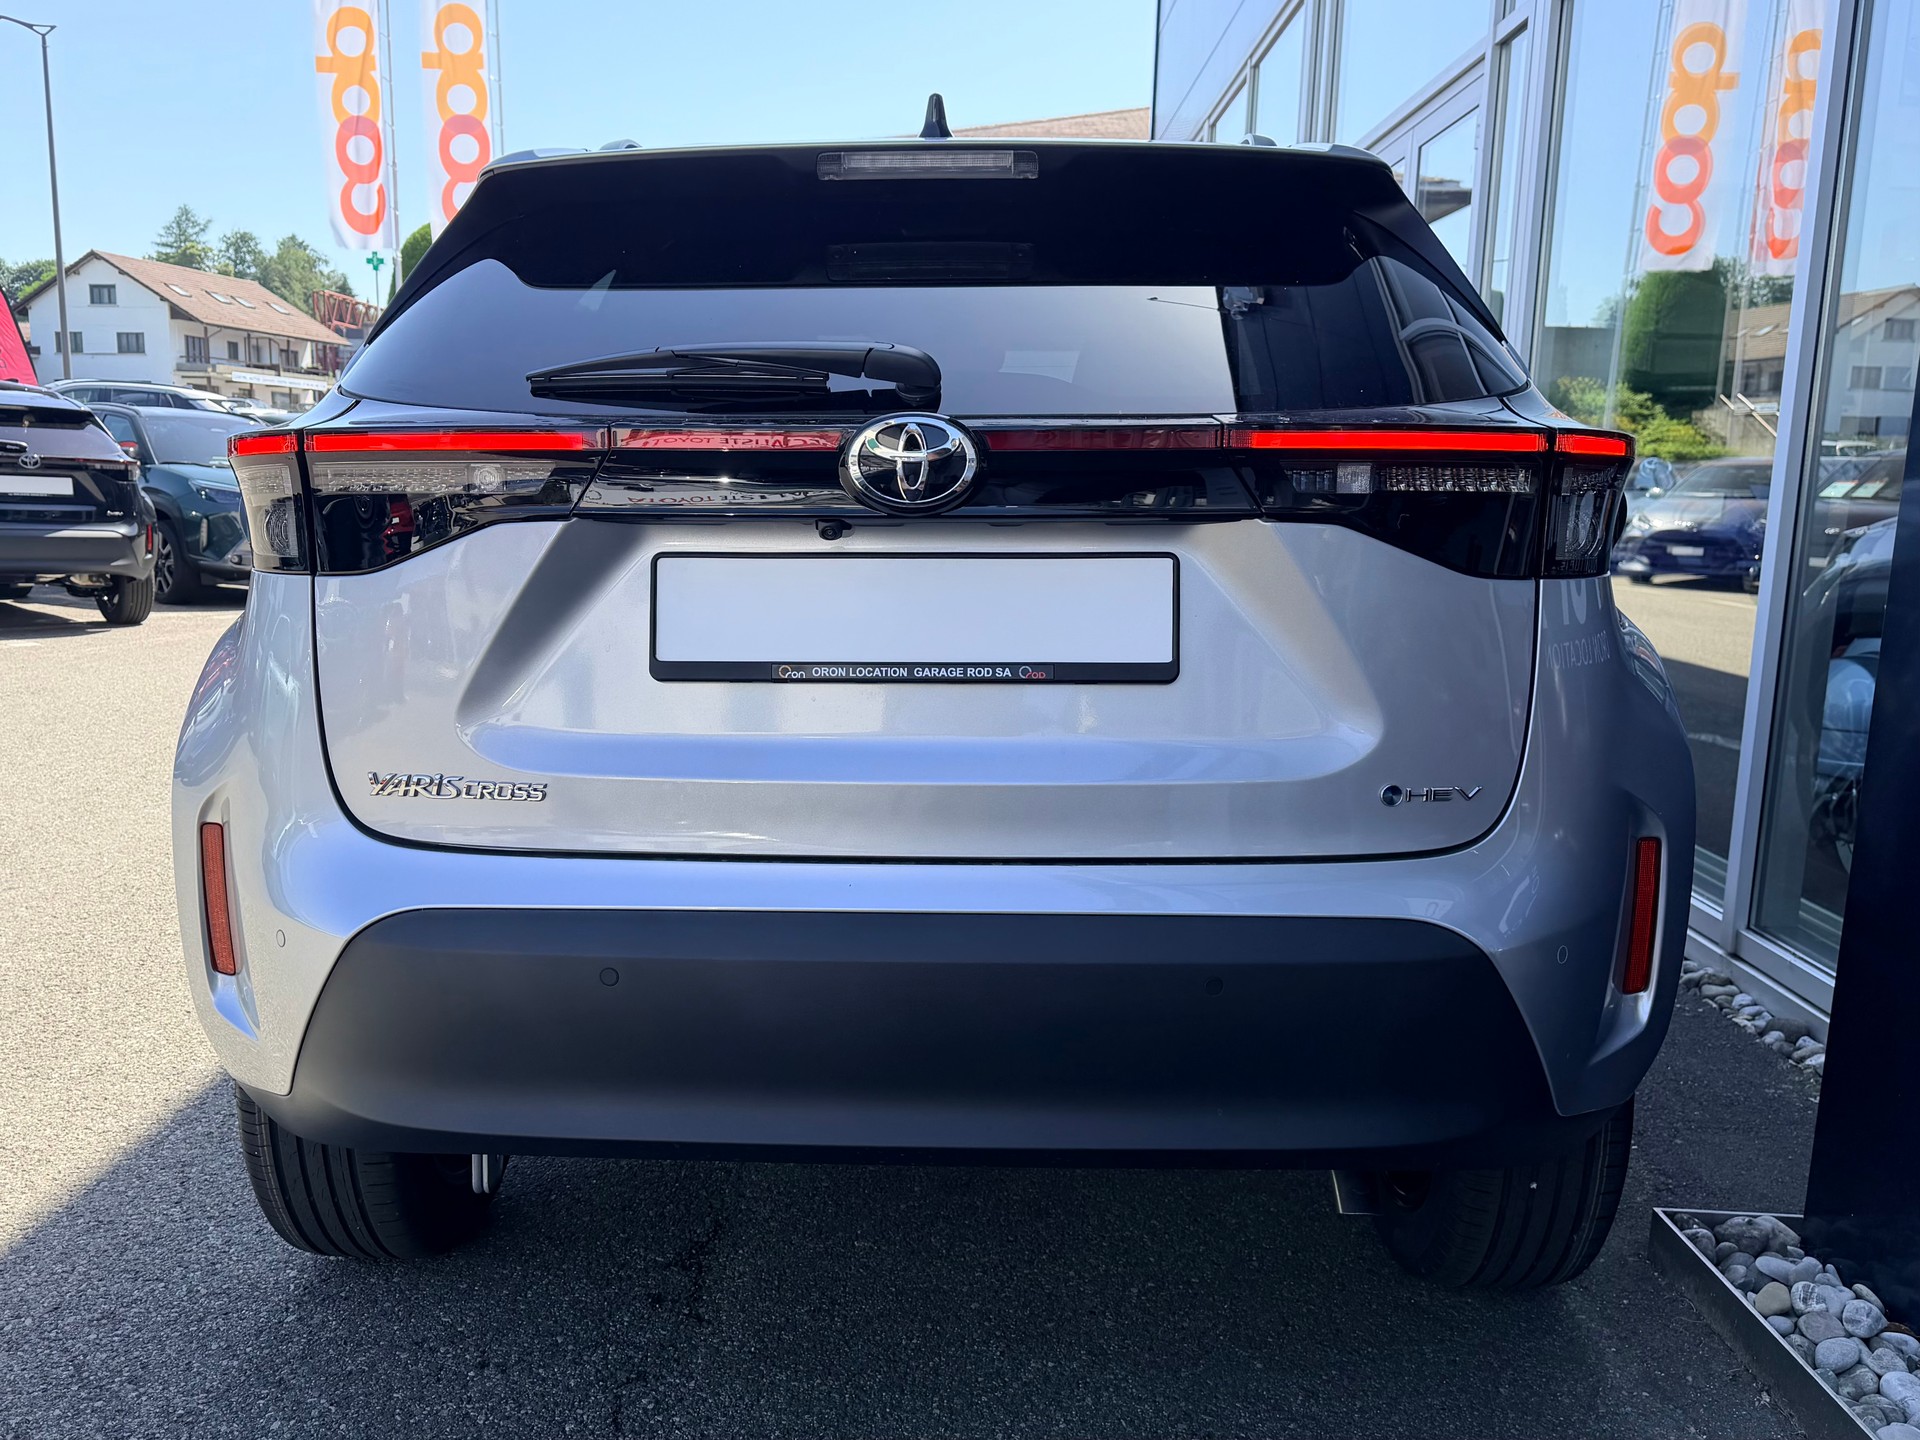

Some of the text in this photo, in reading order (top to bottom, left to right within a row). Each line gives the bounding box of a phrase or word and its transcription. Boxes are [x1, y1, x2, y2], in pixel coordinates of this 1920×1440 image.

[1645, 21, 1741, 256] coop
[812, 667, 1012, 677] ORON LOCATION GARAGE ROD SA
[462, 780, 548, 802] CROSS
[1405, 786, 1483, 803] HEV
